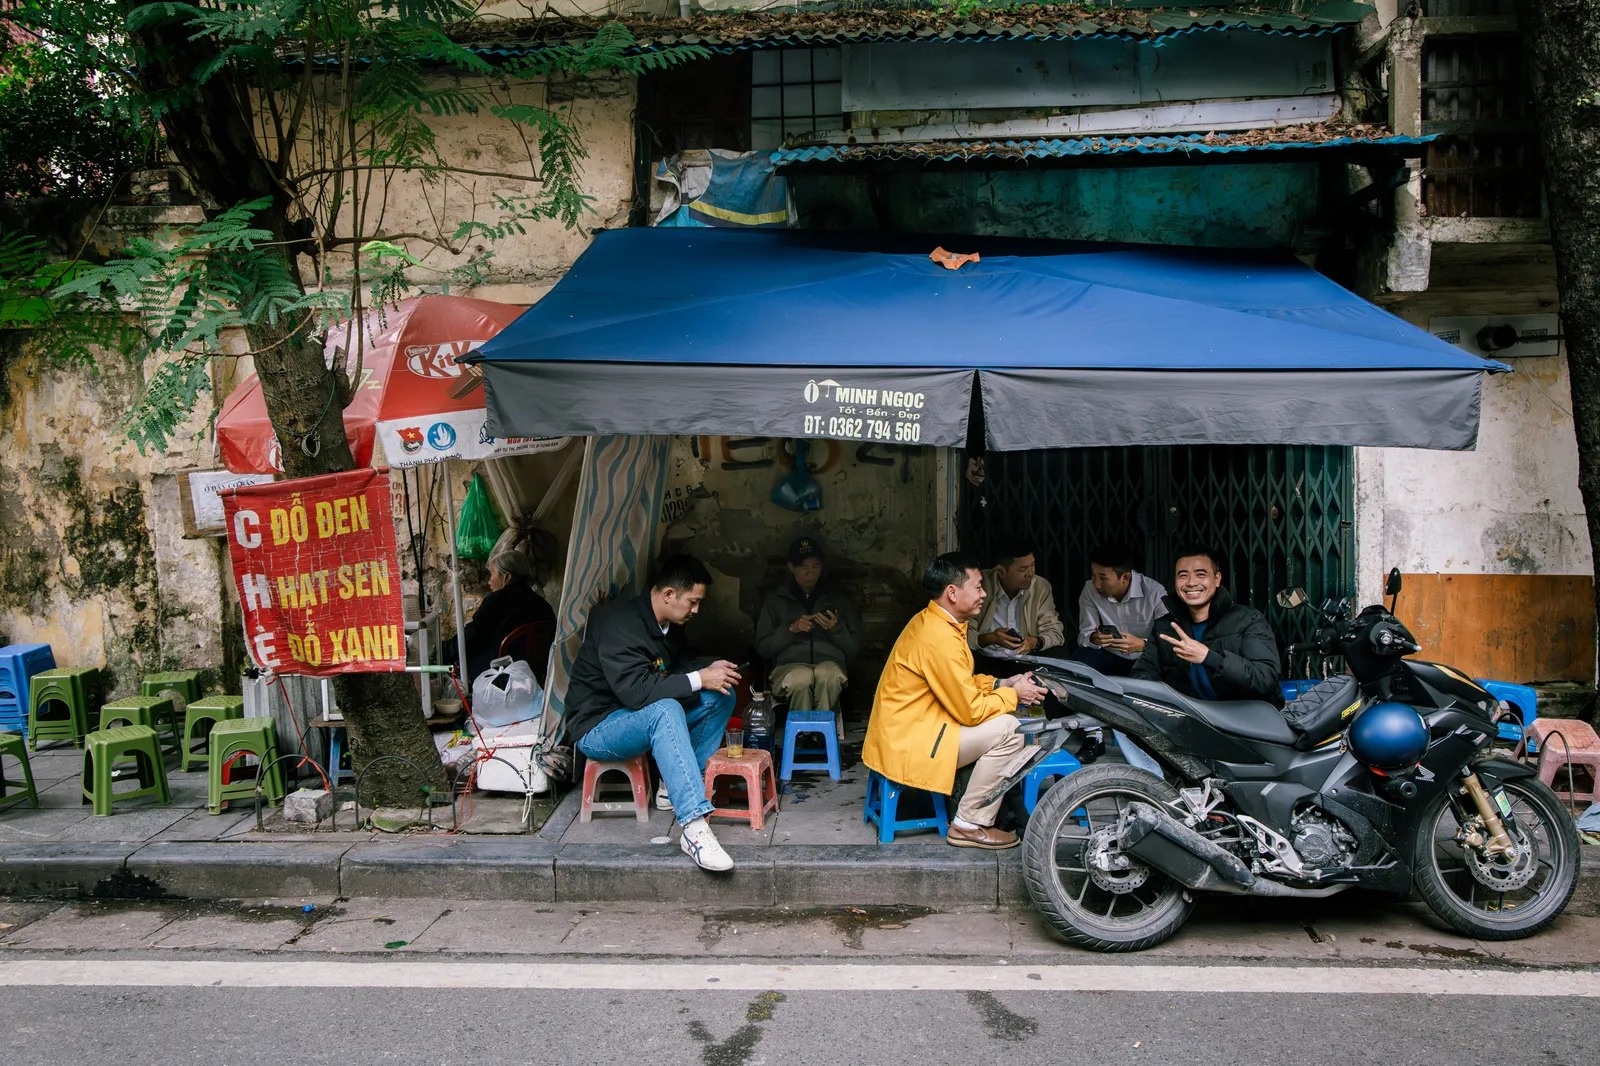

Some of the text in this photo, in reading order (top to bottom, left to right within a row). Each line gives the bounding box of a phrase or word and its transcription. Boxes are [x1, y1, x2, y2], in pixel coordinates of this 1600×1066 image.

[835, 387, 877, 405] MINH
[881, 390, 925, 412] NGỌC
[839, 405, 856, 415] Tốt
[898, 410, 920, 421] Đẹp
[804, 415, 920, 442] ĐT: 0362 794 560
[270, 492, 309, 546] ĐỖ
[315, 494, 370, 539] ĐEN
[276, 559, 391, 617] HẠT SEN
[287, 622, 400, 667] ĐỖ XANH
